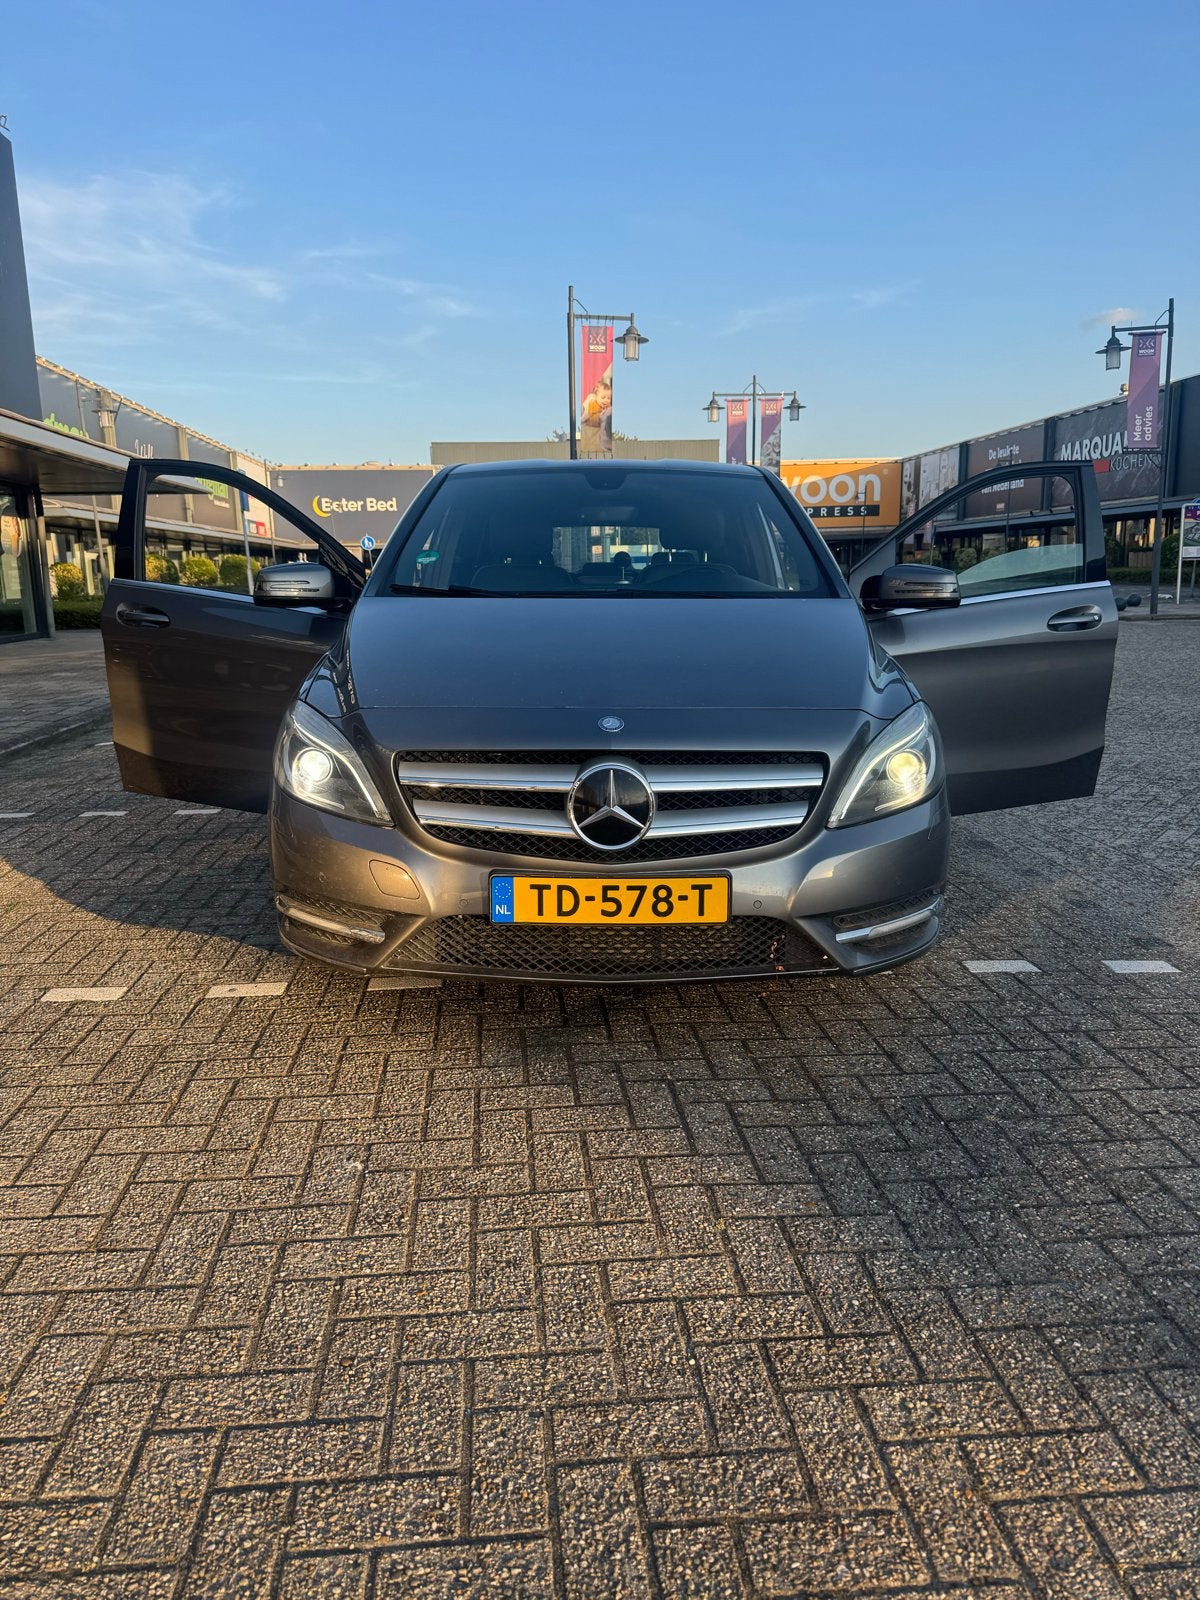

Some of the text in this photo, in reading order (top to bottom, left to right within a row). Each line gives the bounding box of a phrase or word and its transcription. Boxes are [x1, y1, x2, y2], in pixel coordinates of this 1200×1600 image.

[1133, 414, 1142, 441] Meer
[1143, 405, 1153, 441] advies
[988, 449, 997, 460] De
[1060, 430, 1130, 461] MARQUA
[992, 479, 1024, 492] Nederand
[366, 497, 398, 512] Bed
[495, 904, 511, 915] NL
[529, 883, 713, 918] TD-578-T
